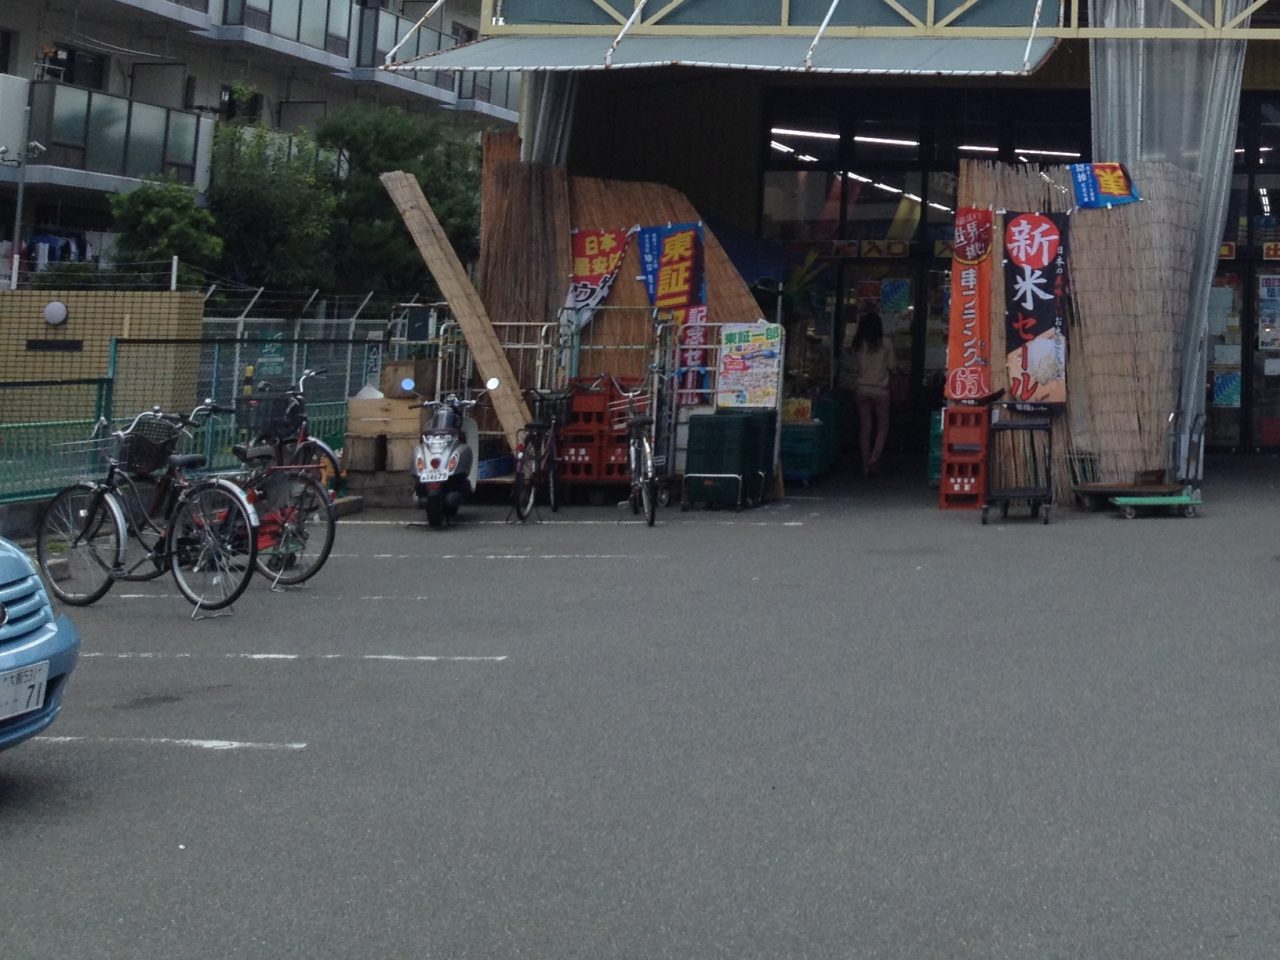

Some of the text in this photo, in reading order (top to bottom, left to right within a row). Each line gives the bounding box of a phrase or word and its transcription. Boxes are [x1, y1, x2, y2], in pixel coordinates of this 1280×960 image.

[1007, 219, 1058, 401] 新米セール
